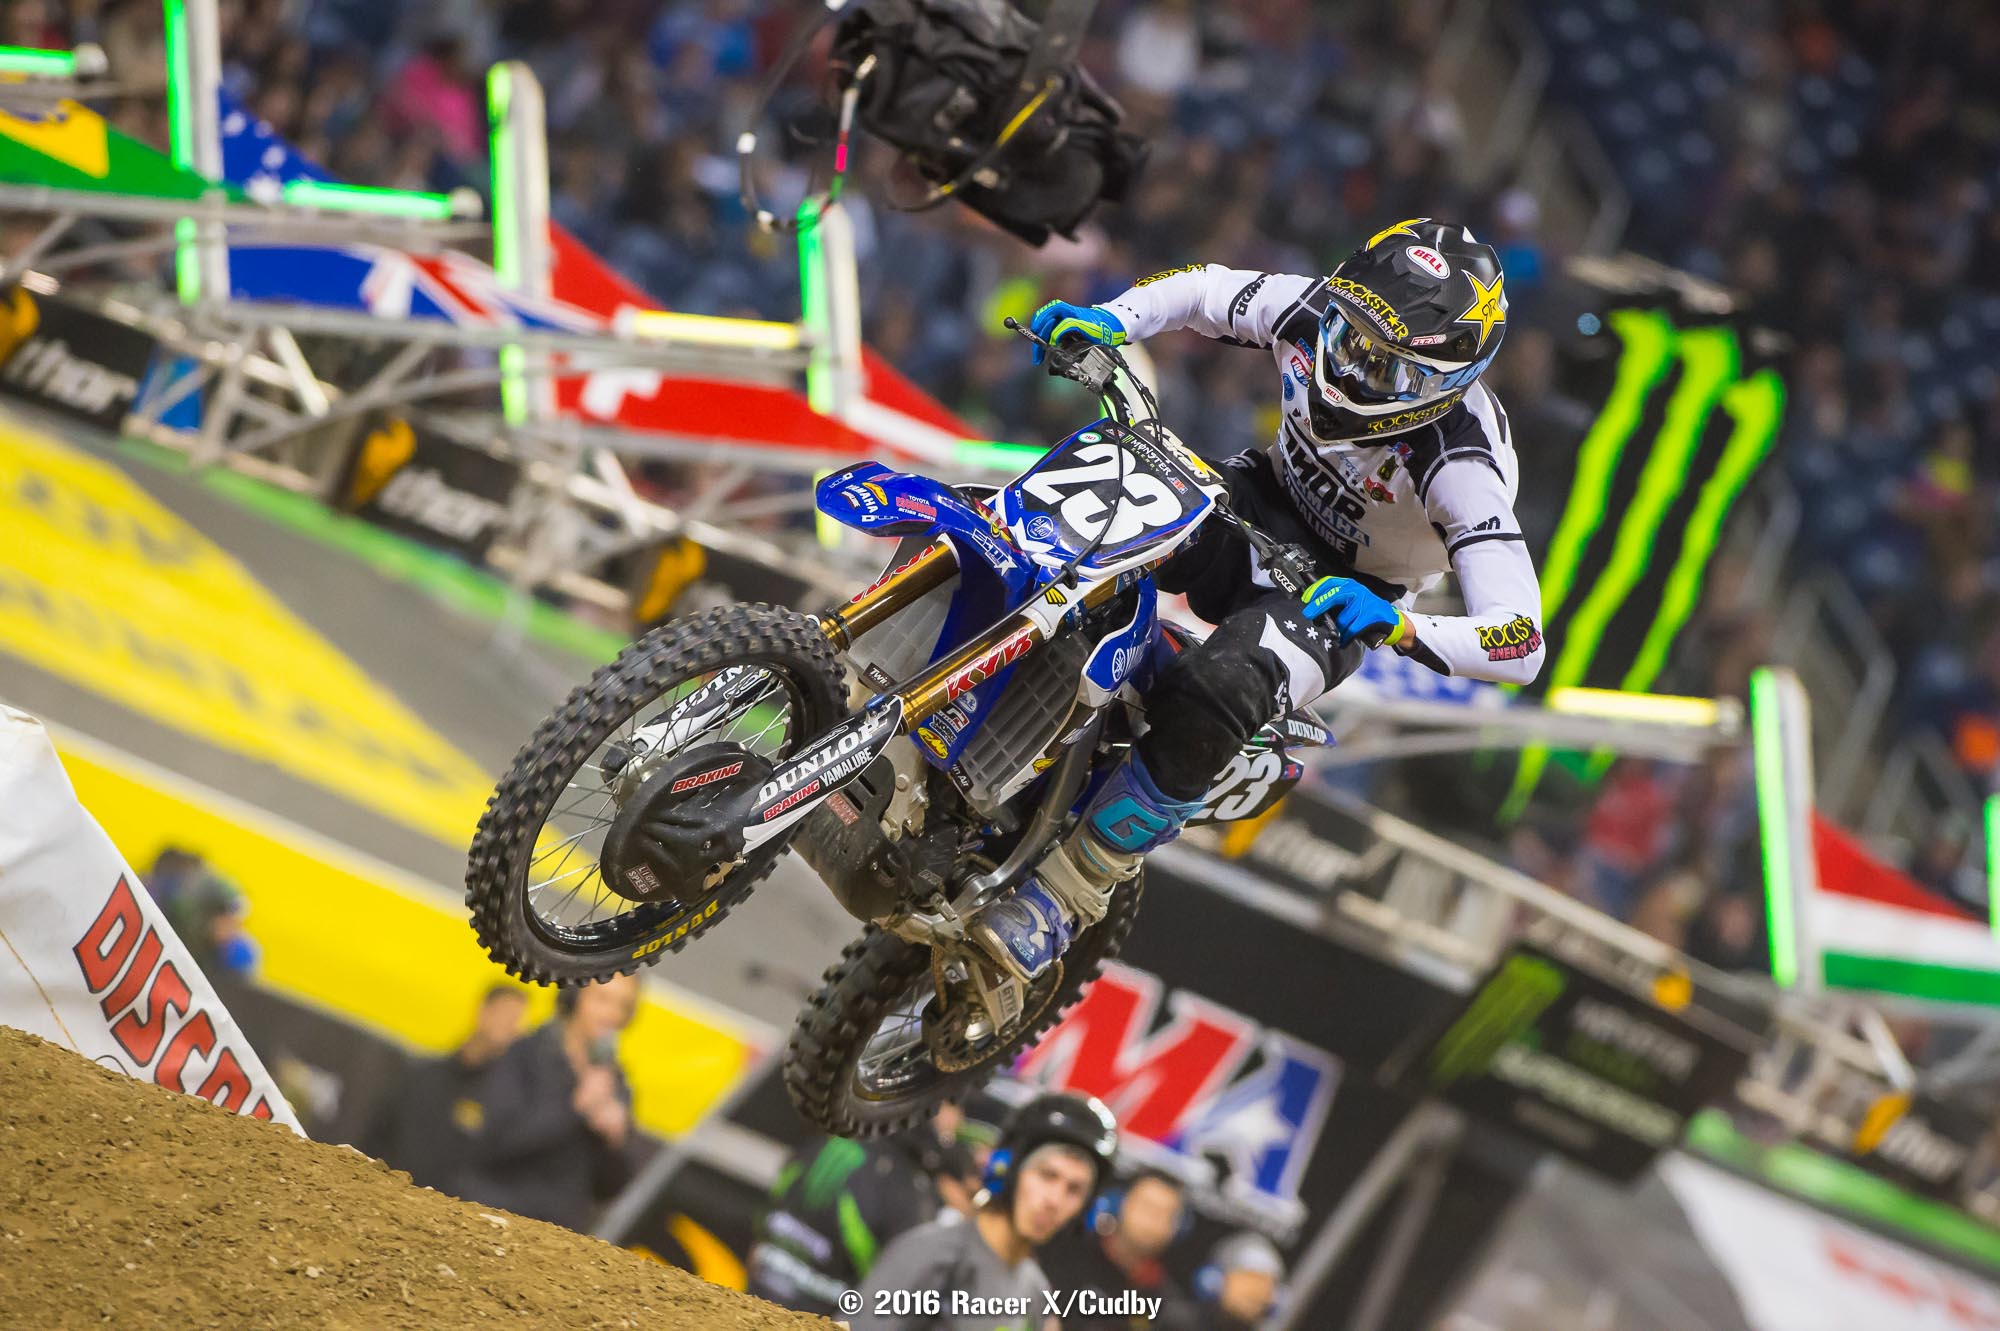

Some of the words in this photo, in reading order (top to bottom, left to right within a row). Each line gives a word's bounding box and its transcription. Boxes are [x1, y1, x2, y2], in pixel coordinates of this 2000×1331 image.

[1413, 249, 1443, 273] BELL
[1327, 285, 1367, 312] ENERGY
[1367, 307, 1395, 340] DRINK
[1325, 387, 1340, 401] BELL
[1131, 438, 1172, 477] MONSTER
[845, 484, 878, 513] YAMAHA
[908, 495, 930, 505] TOYOTA
[1022, 443, 1183, 545] 23
[1273, 567, 1297, 593] ARC
[945, 628, 1032, 703] KYB
[672, 664, 750, 720] NLOP
[1287, 718, 1327, 744] DUNLOP
[671, 761, 744, 794] BRAKING
[758, 715, 888, 806] DUNLOP
[820, 746, 873, 788] YAMALUBE
[959, 773, 970, 787] Air
[763, 780, 821, 822] BRAKING
[1190, 752, 1282, 821] 23
[627, 870, 650, 895] SPEED
[639, 866, 661, 889] LIGHT
[631, 899, 720, 960] DUNLOP
[73, 873, 273, 1122] DISCO
